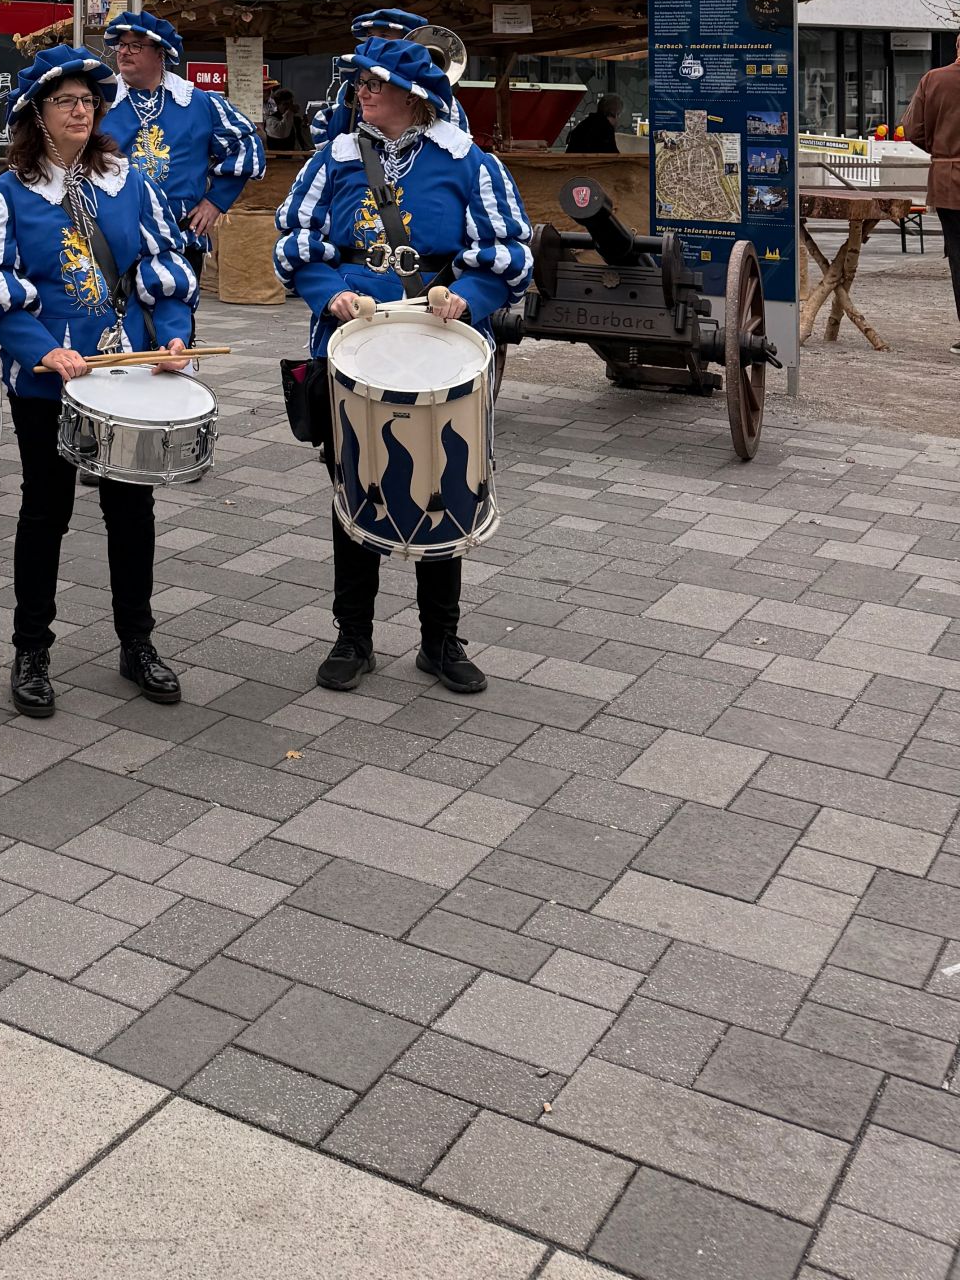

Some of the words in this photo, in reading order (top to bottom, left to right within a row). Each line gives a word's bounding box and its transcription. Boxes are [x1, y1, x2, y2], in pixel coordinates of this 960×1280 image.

[196, 72, 211, 83] GIM
[212, 72, 222, 84] &
[683, 226, 737, 237] Informationen
